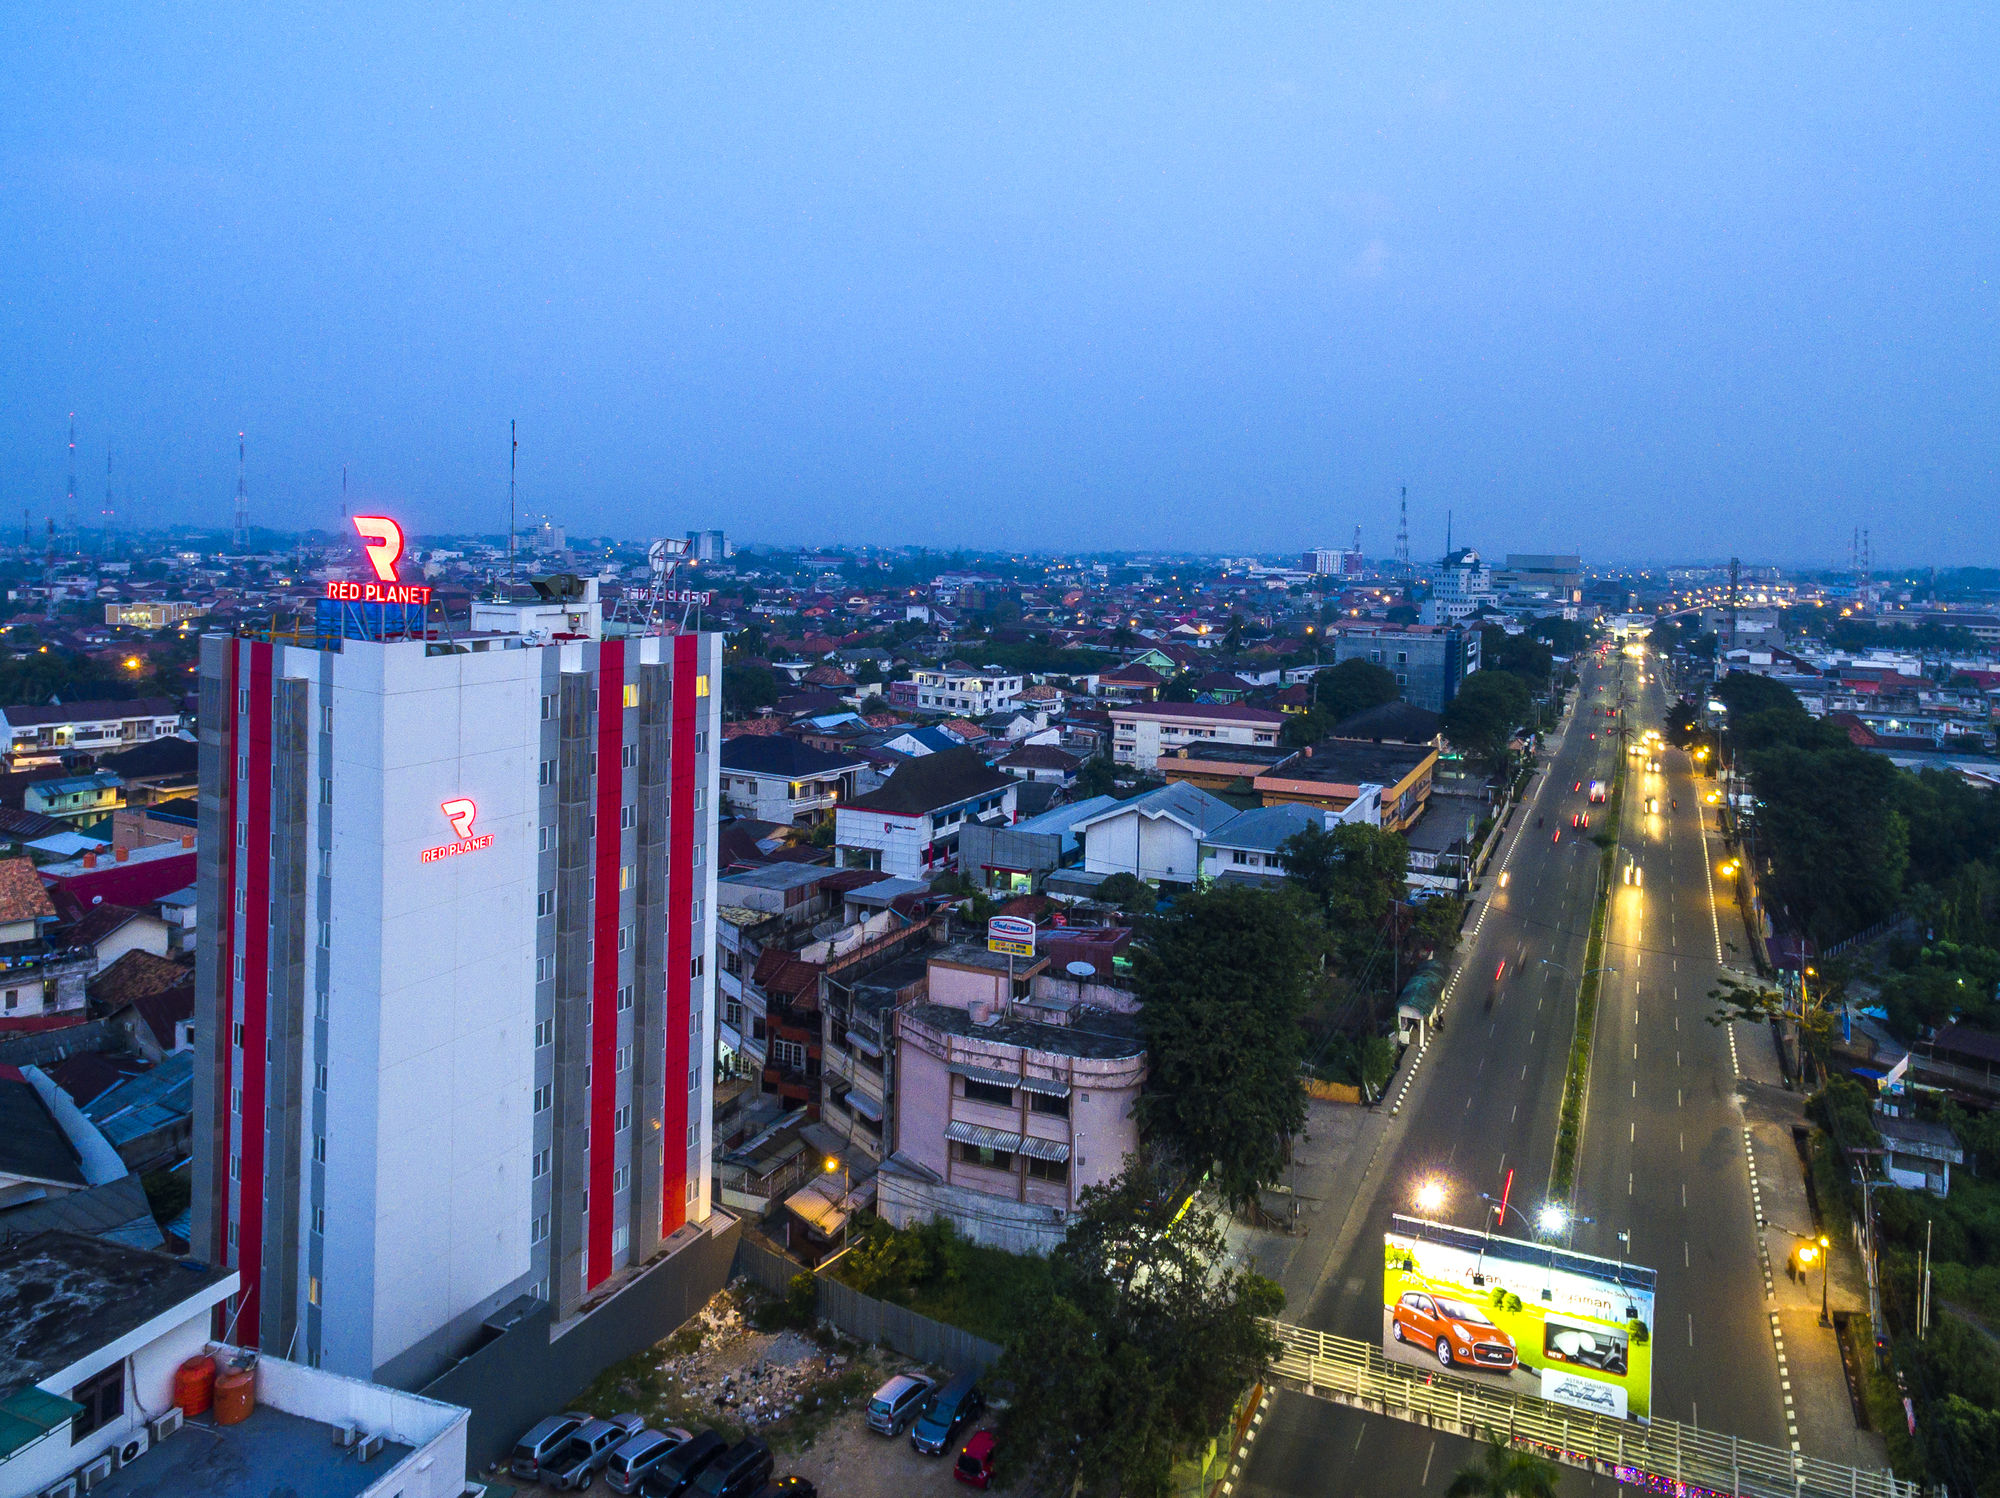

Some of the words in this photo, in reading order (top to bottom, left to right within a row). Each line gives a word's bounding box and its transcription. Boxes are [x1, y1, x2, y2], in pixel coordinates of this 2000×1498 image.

[327, 582, 360, 600] RED
[364, 584, 431, 605] PLANET
[422, 846, 447, 864] RED
[448, 834, 495, 857] PLANET
[1547, 1350, 1563, 1359] NEW
